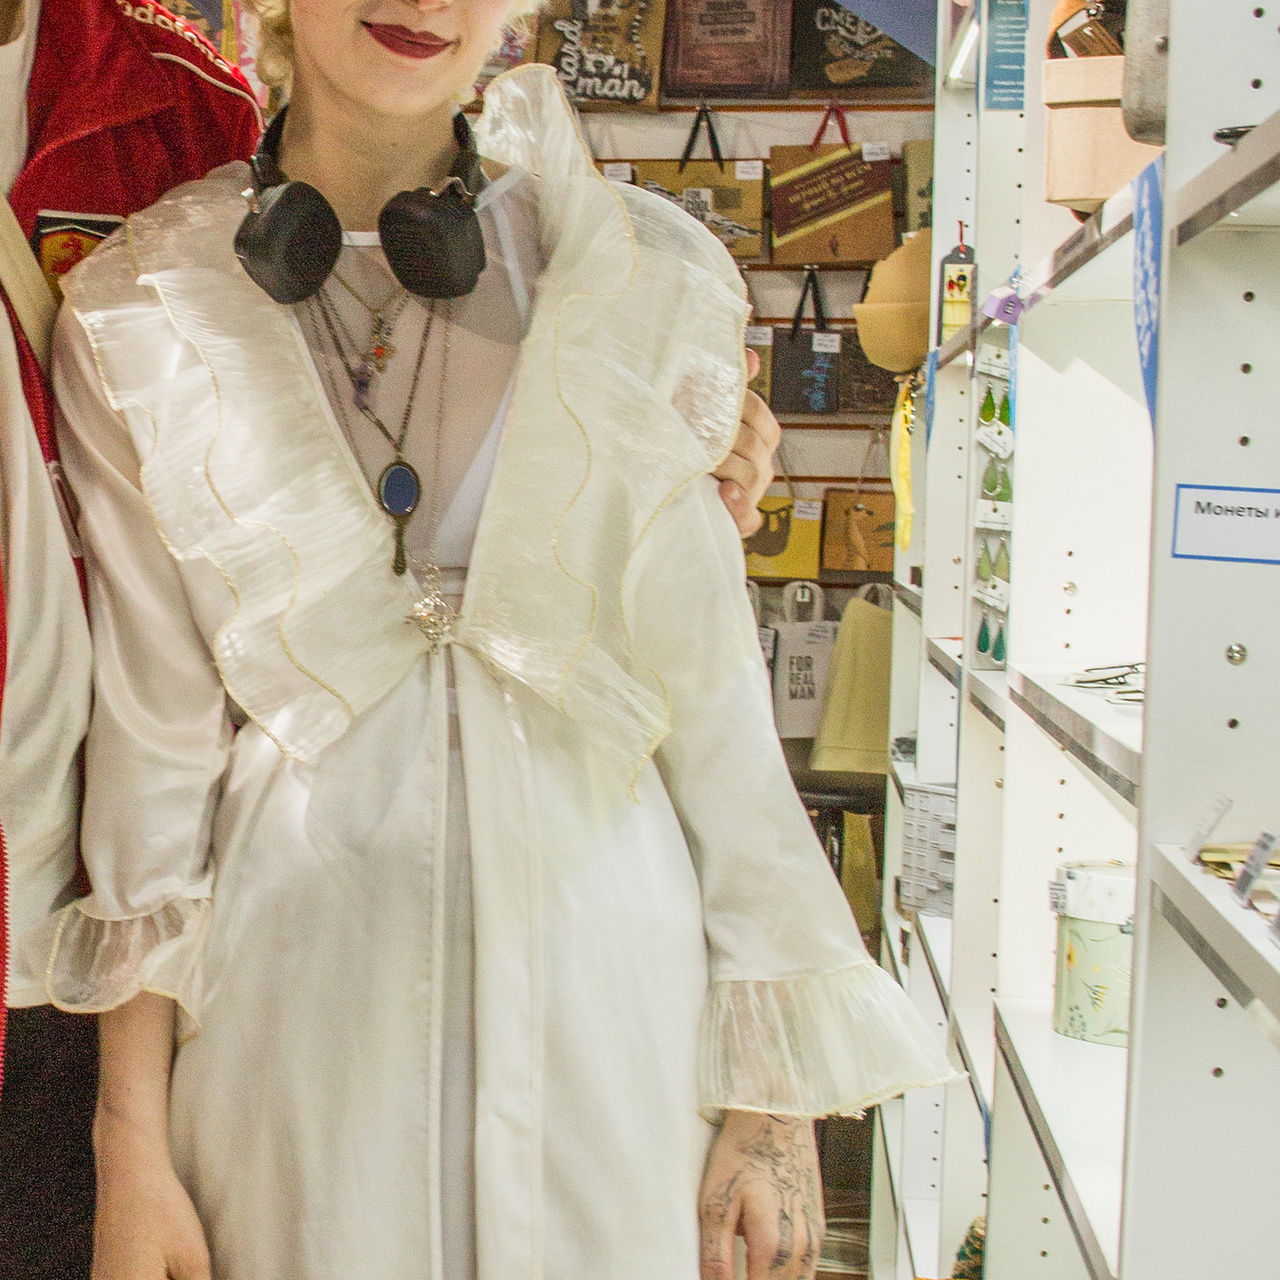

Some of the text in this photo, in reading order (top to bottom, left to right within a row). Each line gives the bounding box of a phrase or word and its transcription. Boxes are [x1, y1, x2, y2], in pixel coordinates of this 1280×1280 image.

[574, 75, 647, 100] man
[1194, 500, 1269, 518] Монеты
[788, 655, 813, 671] FOR
[788, 672, 815, 686] REAL
[788, 685, 816, 700] MAN
